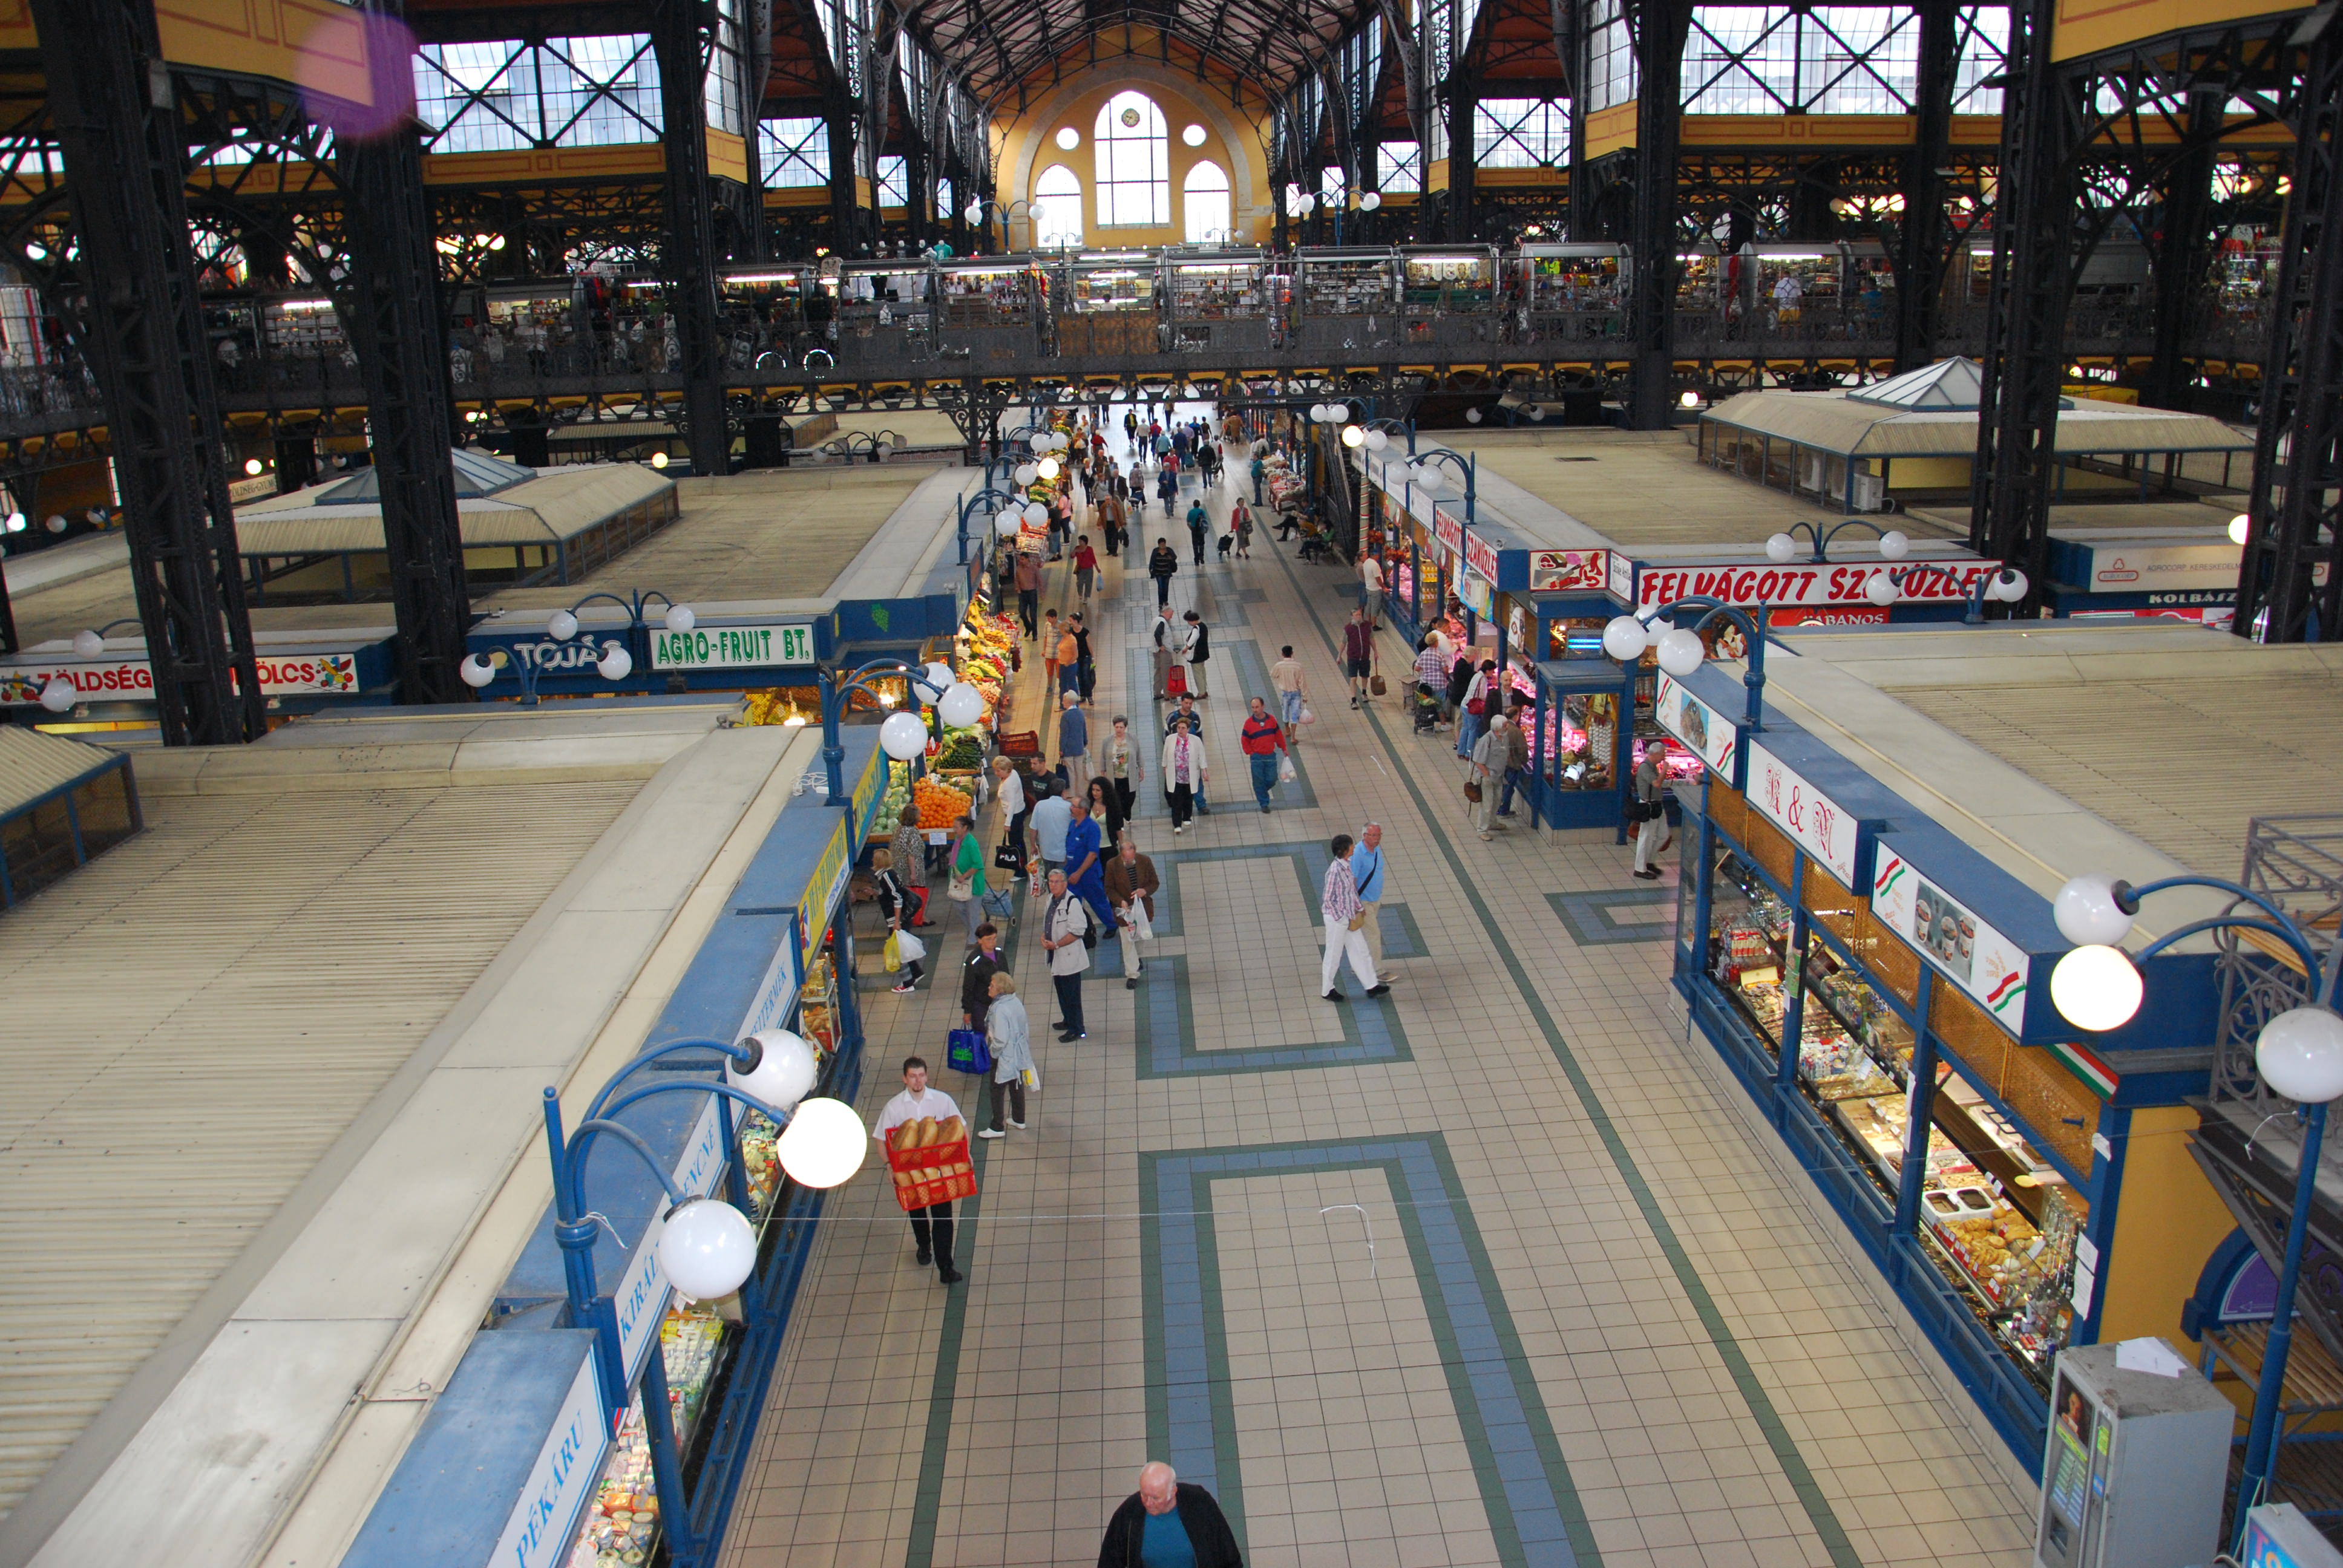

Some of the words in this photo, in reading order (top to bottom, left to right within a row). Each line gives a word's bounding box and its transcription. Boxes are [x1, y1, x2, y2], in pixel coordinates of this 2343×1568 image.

[1641, 567, 1818, 605] FELVÁGOTT
[2149, 591, 2238, 604] KOLBÁSZ
[1803, 613, 1884, 626] ABANOS
[658, 630, 771, 665] AGRO-FRUIT
[783, 629, 810, 661] BT.
[1788, 785, 1804, 833] &
[999, 853, 1017, 862] FILA
[750, 961, 787, 1036] EJTERMÉK
[683, 1118, 715, 1197] ENCNÉ
[620, 1240, 660, 1344] KIRÁL
[516, 1408, 585, 1568] PÉKÁRU
